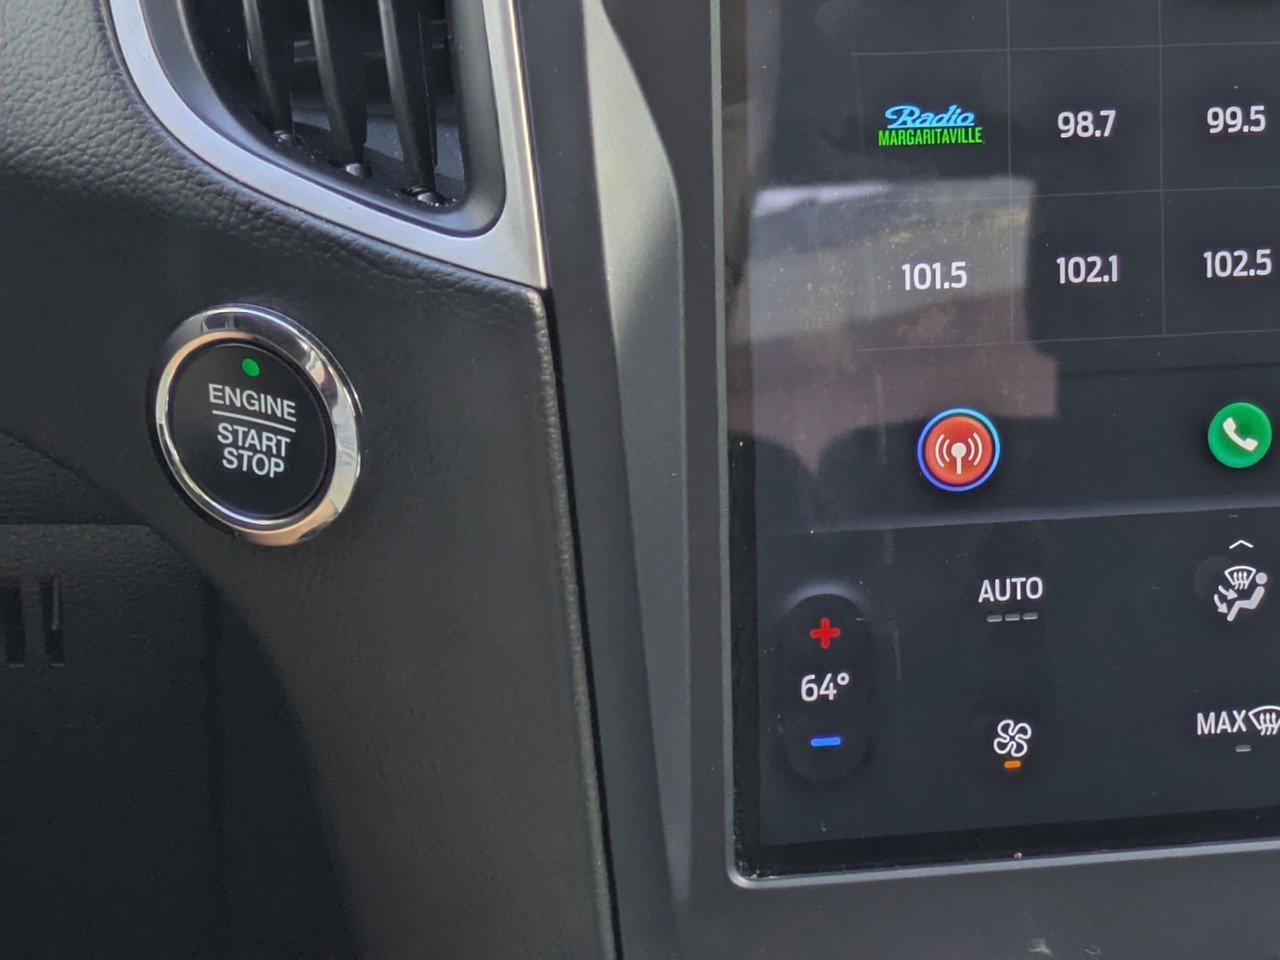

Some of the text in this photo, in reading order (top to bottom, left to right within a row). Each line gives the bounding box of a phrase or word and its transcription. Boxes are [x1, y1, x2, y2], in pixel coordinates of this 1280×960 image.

[884, 104, 975, 129] Radio
[1056, 109, 1117, 139] 98.7
[1206, 105, 1267, 134] 99.5
[877, 127, 983, 146] MARGARITAVILLE
[901, 261, 968, 291] 101.5
[1056, 255, 1120, 284] 102.1
[1203, 248, 1273, 279] 102.5
[208, 383, 297, 422] ENGINE
[217, 423, 290, 457] START
[222, 447, 285, 478] STOP
[977, 576, 1044, 604] AUTO
[800, 672, 851, 702] 64°
[1196, 709, 1247, 735] MAX
